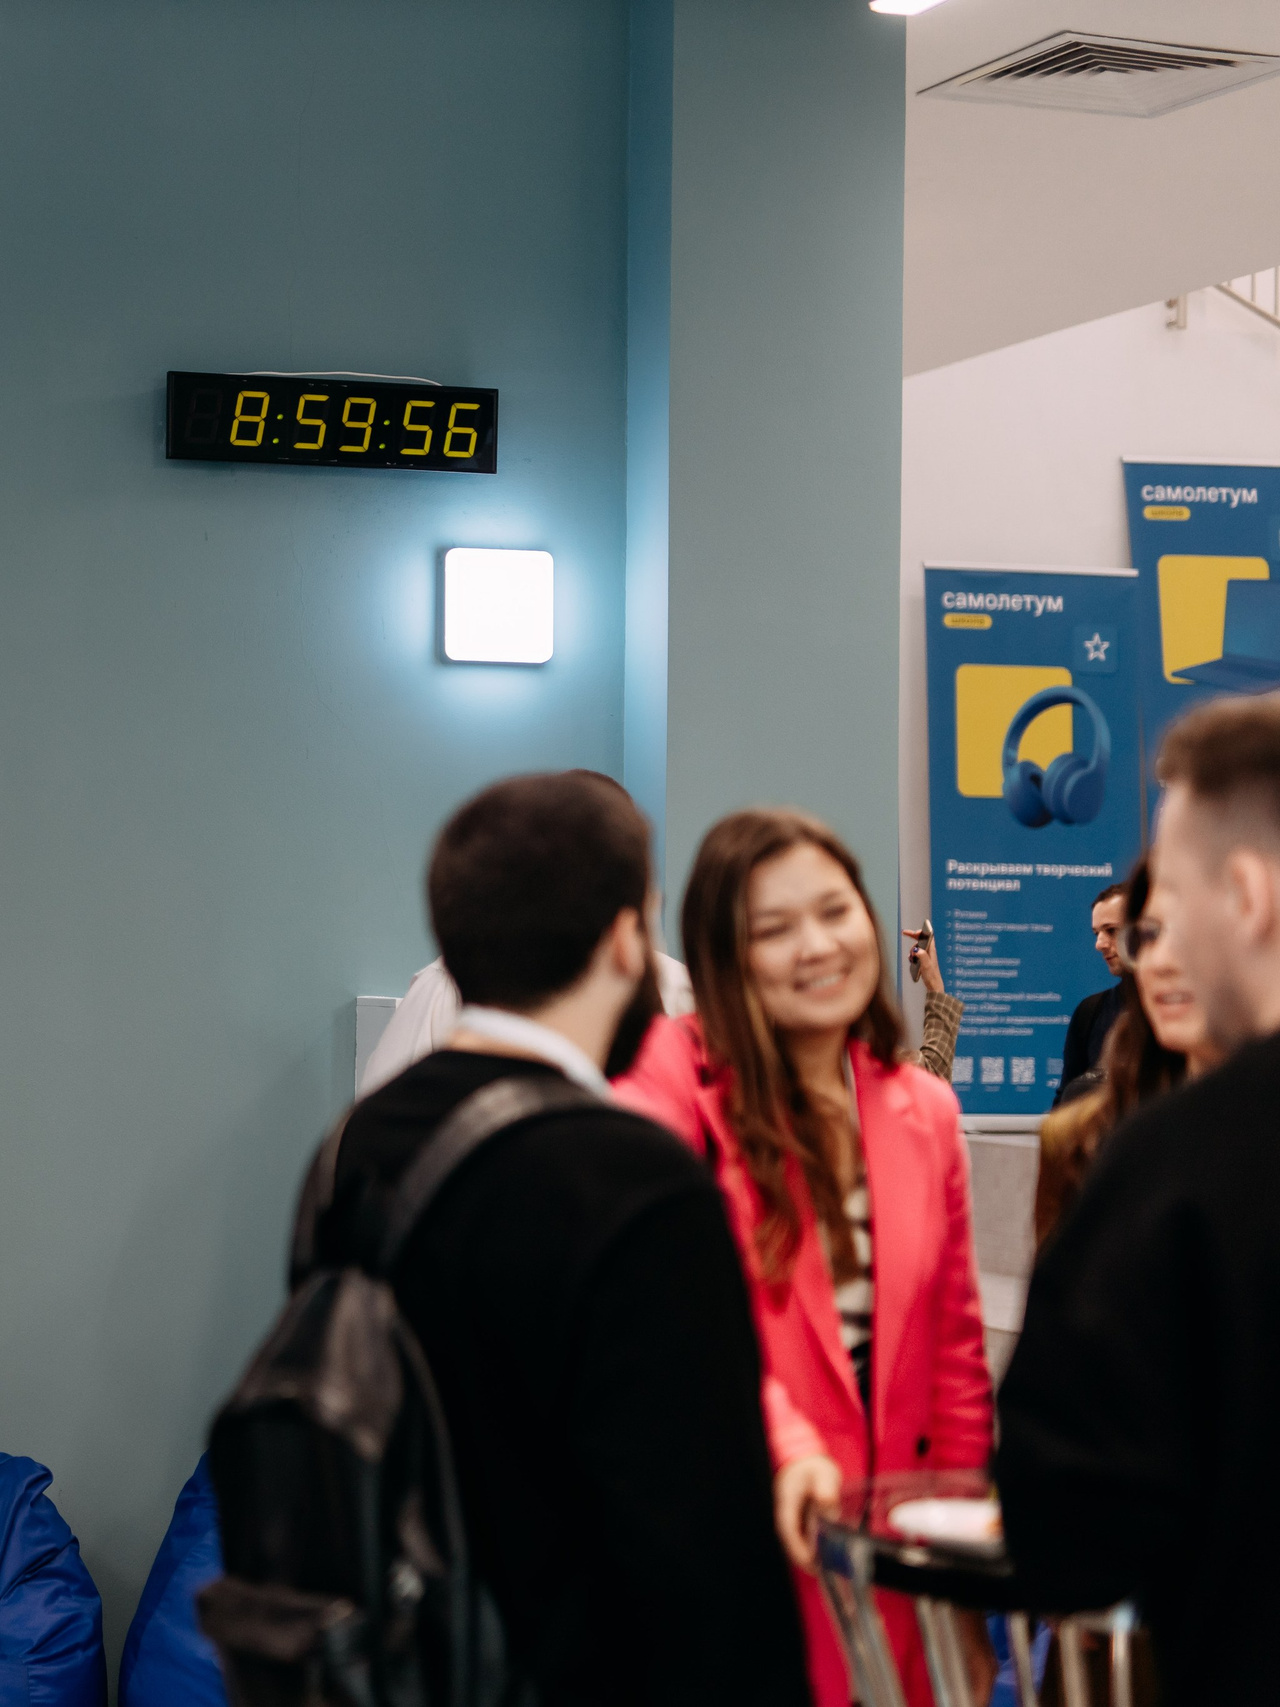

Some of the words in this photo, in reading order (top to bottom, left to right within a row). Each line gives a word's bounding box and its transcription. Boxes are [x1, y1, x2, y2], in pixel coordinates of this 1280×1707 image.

[230, 391, 480, 457] 8:59:56
[1142, 485, 1258, 508] самолетум
[943, 592, 1063, 617] самолетум
[947, 860, 1033, 876] Раскрываем
[1036, 863, 1112, 878] творческий
[947, 878, 1020, 891] потенциал
